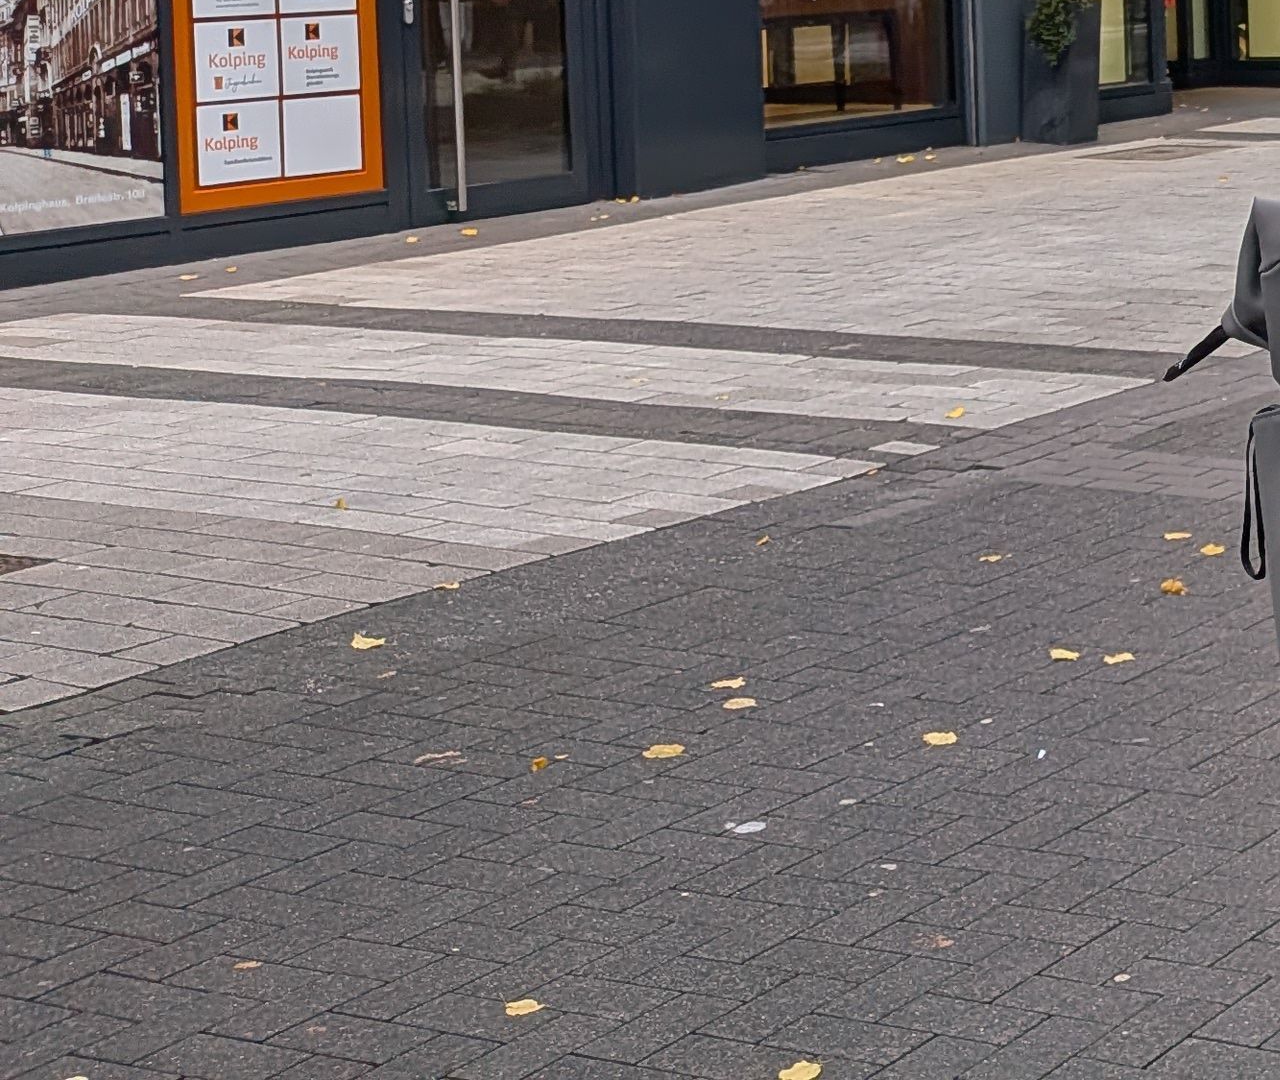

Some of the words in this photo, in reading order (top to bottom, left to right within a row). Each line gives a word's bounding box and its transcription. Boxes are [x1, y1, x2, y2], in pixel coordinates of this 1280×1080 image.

[208, 52, 266, 69] Kolping
[288, 45, 339, 61] Kolping
[205, 135, 258, 152] Kolping
